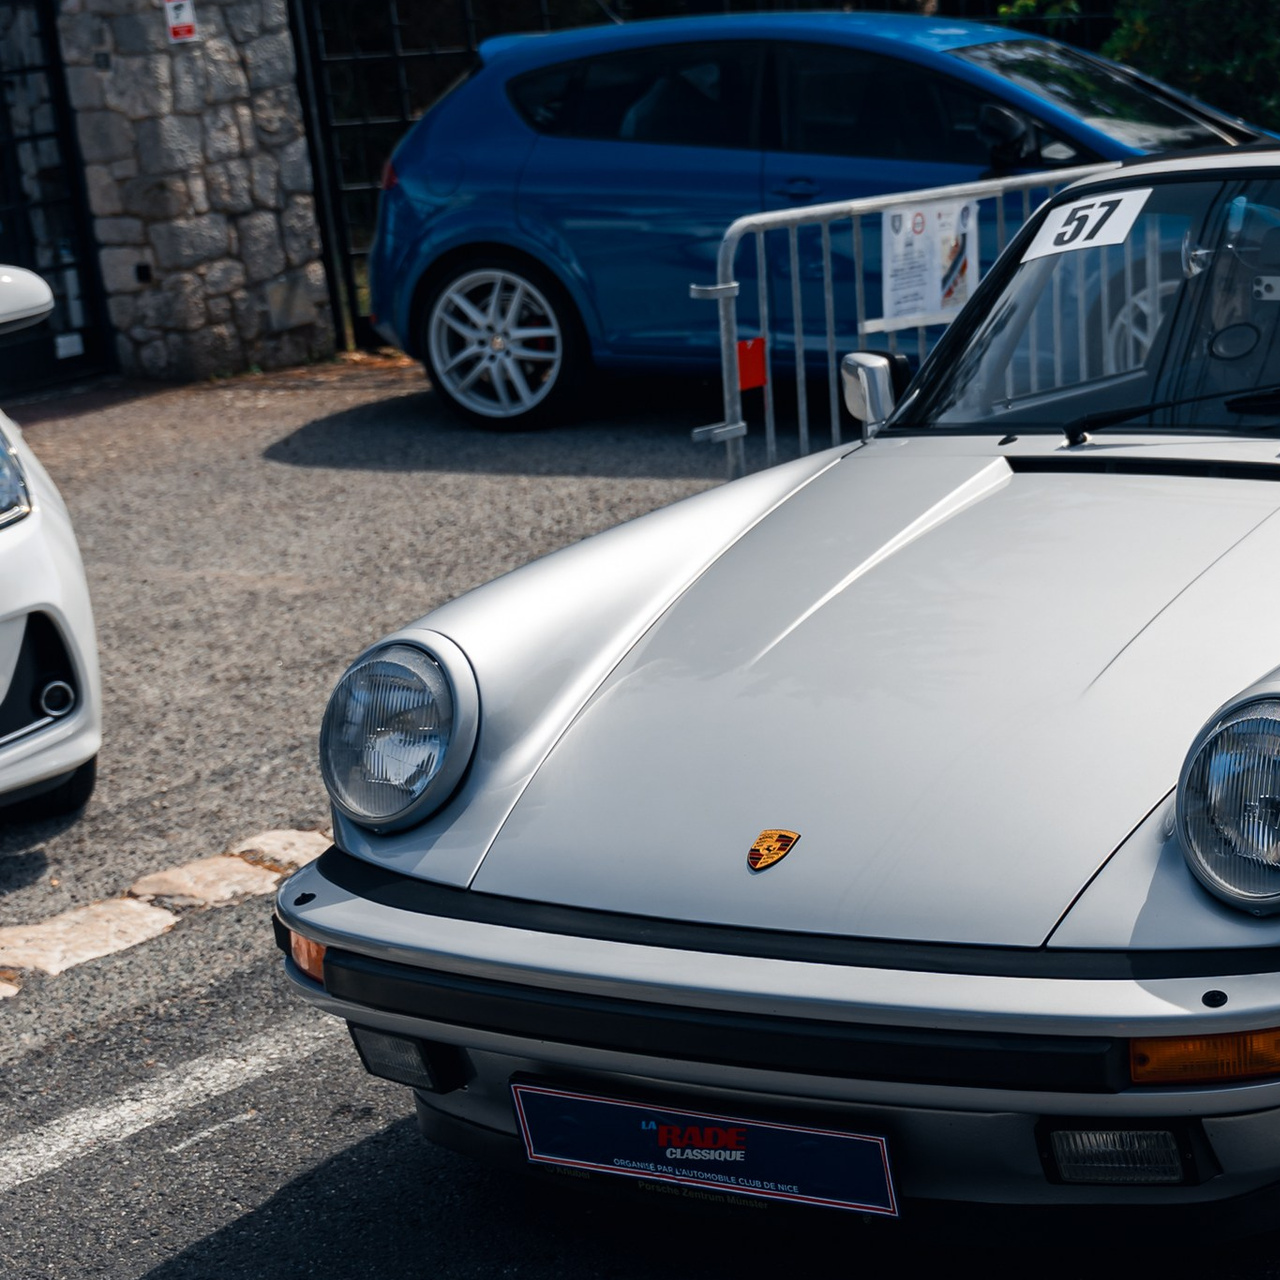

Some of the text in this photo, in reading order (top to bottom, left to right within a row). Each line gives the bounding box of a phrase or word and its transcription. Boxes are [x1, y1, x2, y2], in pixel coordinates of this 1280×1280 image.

[1053, 198, 1123, 246] 57
[641, 1120, 657, 1130] LA
[657, 1124, 747, 1150] RADE
[666, 1148, 745, 1162] CLASSIQUE
[613, 1158, 799, 1194] ORGANISÉ PAR L'AUTOMOBILE CLUB DE NICE
[638, 1180, 680, 1197] Porsche
[682, 1186, 724, 1203] Zentrum
